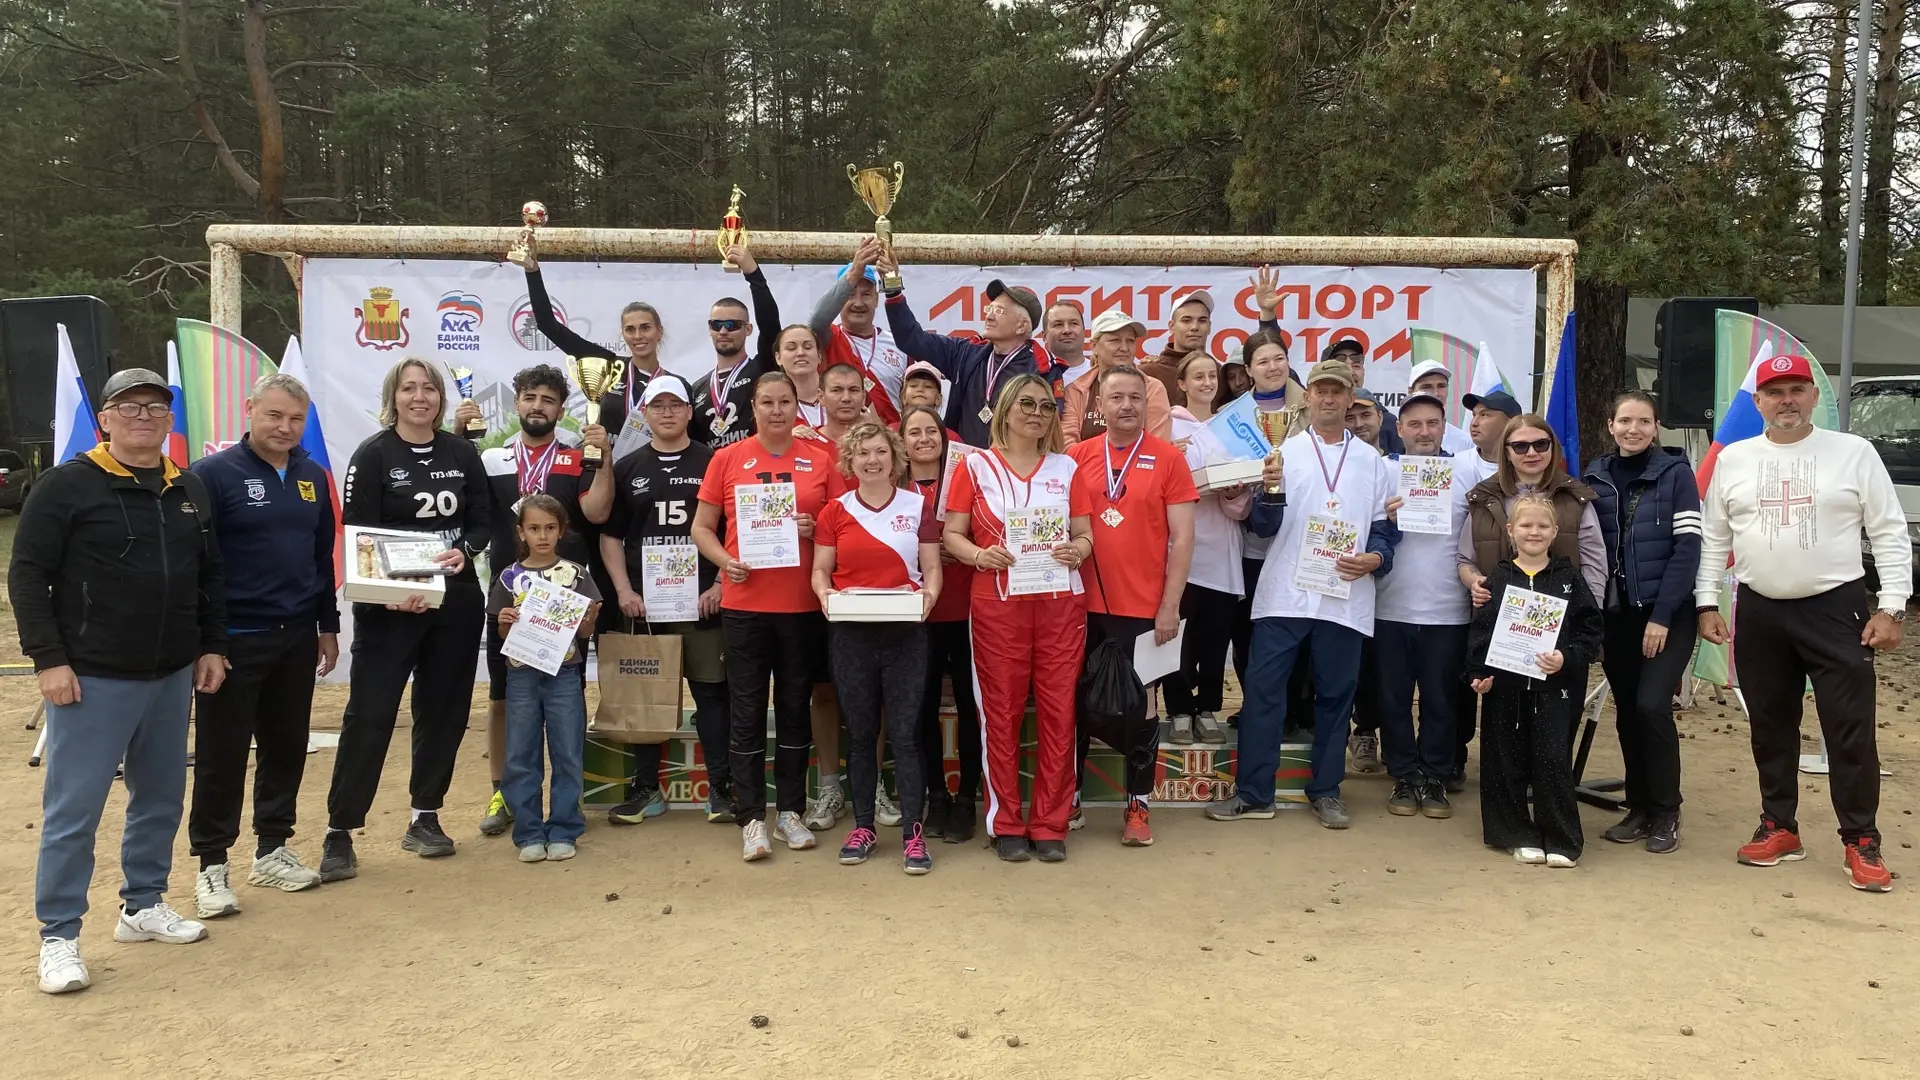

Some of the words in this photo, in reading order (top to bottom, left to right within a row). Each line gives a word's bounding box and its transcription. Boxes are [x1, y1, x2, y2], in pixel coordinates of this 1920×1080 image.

[1234, 284, 1433, 321] СПОРТ
[437, 334, 480, 343] ЕДИНАЯ
[437, 342, 480, 351] РОССИЯ
[629, 419, 645, 431] XXI
[555, 453, 572, 466] КБ
[1402, 464, 1418, 473] XXI
[430, 470, 445, 480] ГУЗ
[669, 477, 683, 485] ГУЗ
[683, 477, 703, 486] «ККБ
[740, 494, 758, 504] XXI
[1409, 488, 1439, 498] ДИПЛОМ
[413, 490, 459, 519] 20
[655, 500, 689, 526] 15
[751, 518, 783, 530] ДИПЛОМ
[1009, 517, 1028, 528] XXI
[1308, 521, 1326, 533] XXI
[1021, 542, 1053, 554] ДИПЛОМ
[646, 554, 663, 563] XXI
[655, 577, 685, 587] ДИПЛОМ
[531, 586, 551, 601] XXI
[1506, 595, 1526, 607] XXI
[528, 614, 562, 633] ДИПЛОМ
[1509, 622, 1544, 638] ДИПЛОМ
[619, 658, 660, 667] ЕДИНАЯ
[619, 666, 660, 676] РОССИЯ
[1180, 750, 1217, 777] III
[659, 781, 711, 801] МЕС
